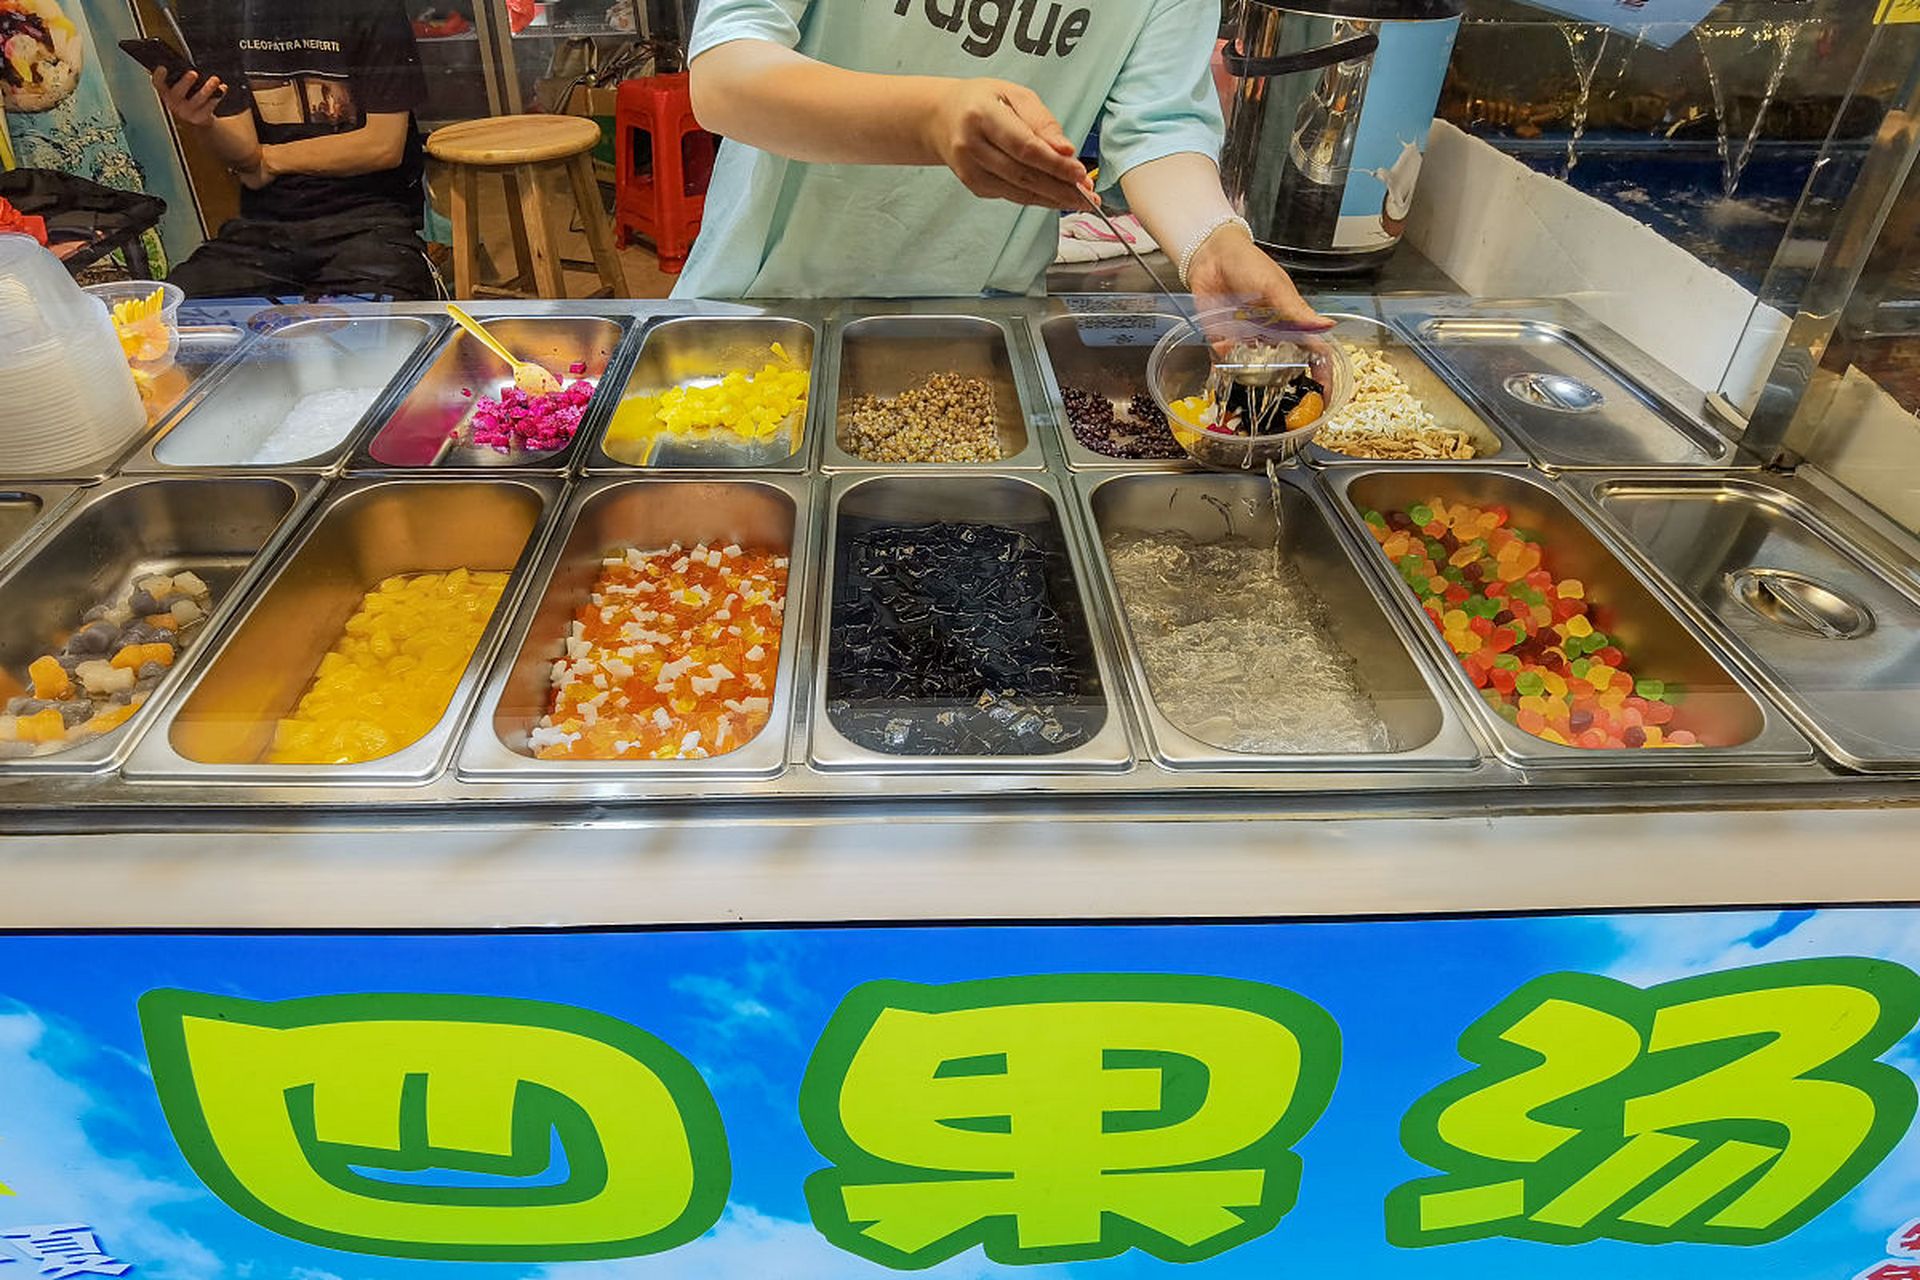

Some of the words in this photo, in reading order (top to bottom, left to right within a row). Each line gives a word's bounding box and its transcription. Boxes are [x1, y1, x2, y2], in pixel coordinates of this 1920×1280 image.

[239, 39, 302, 51] CLEOPATRA
[178, 982, 1884, 1261] 四果汤
[0, 1223, 132, 1280] 夏
